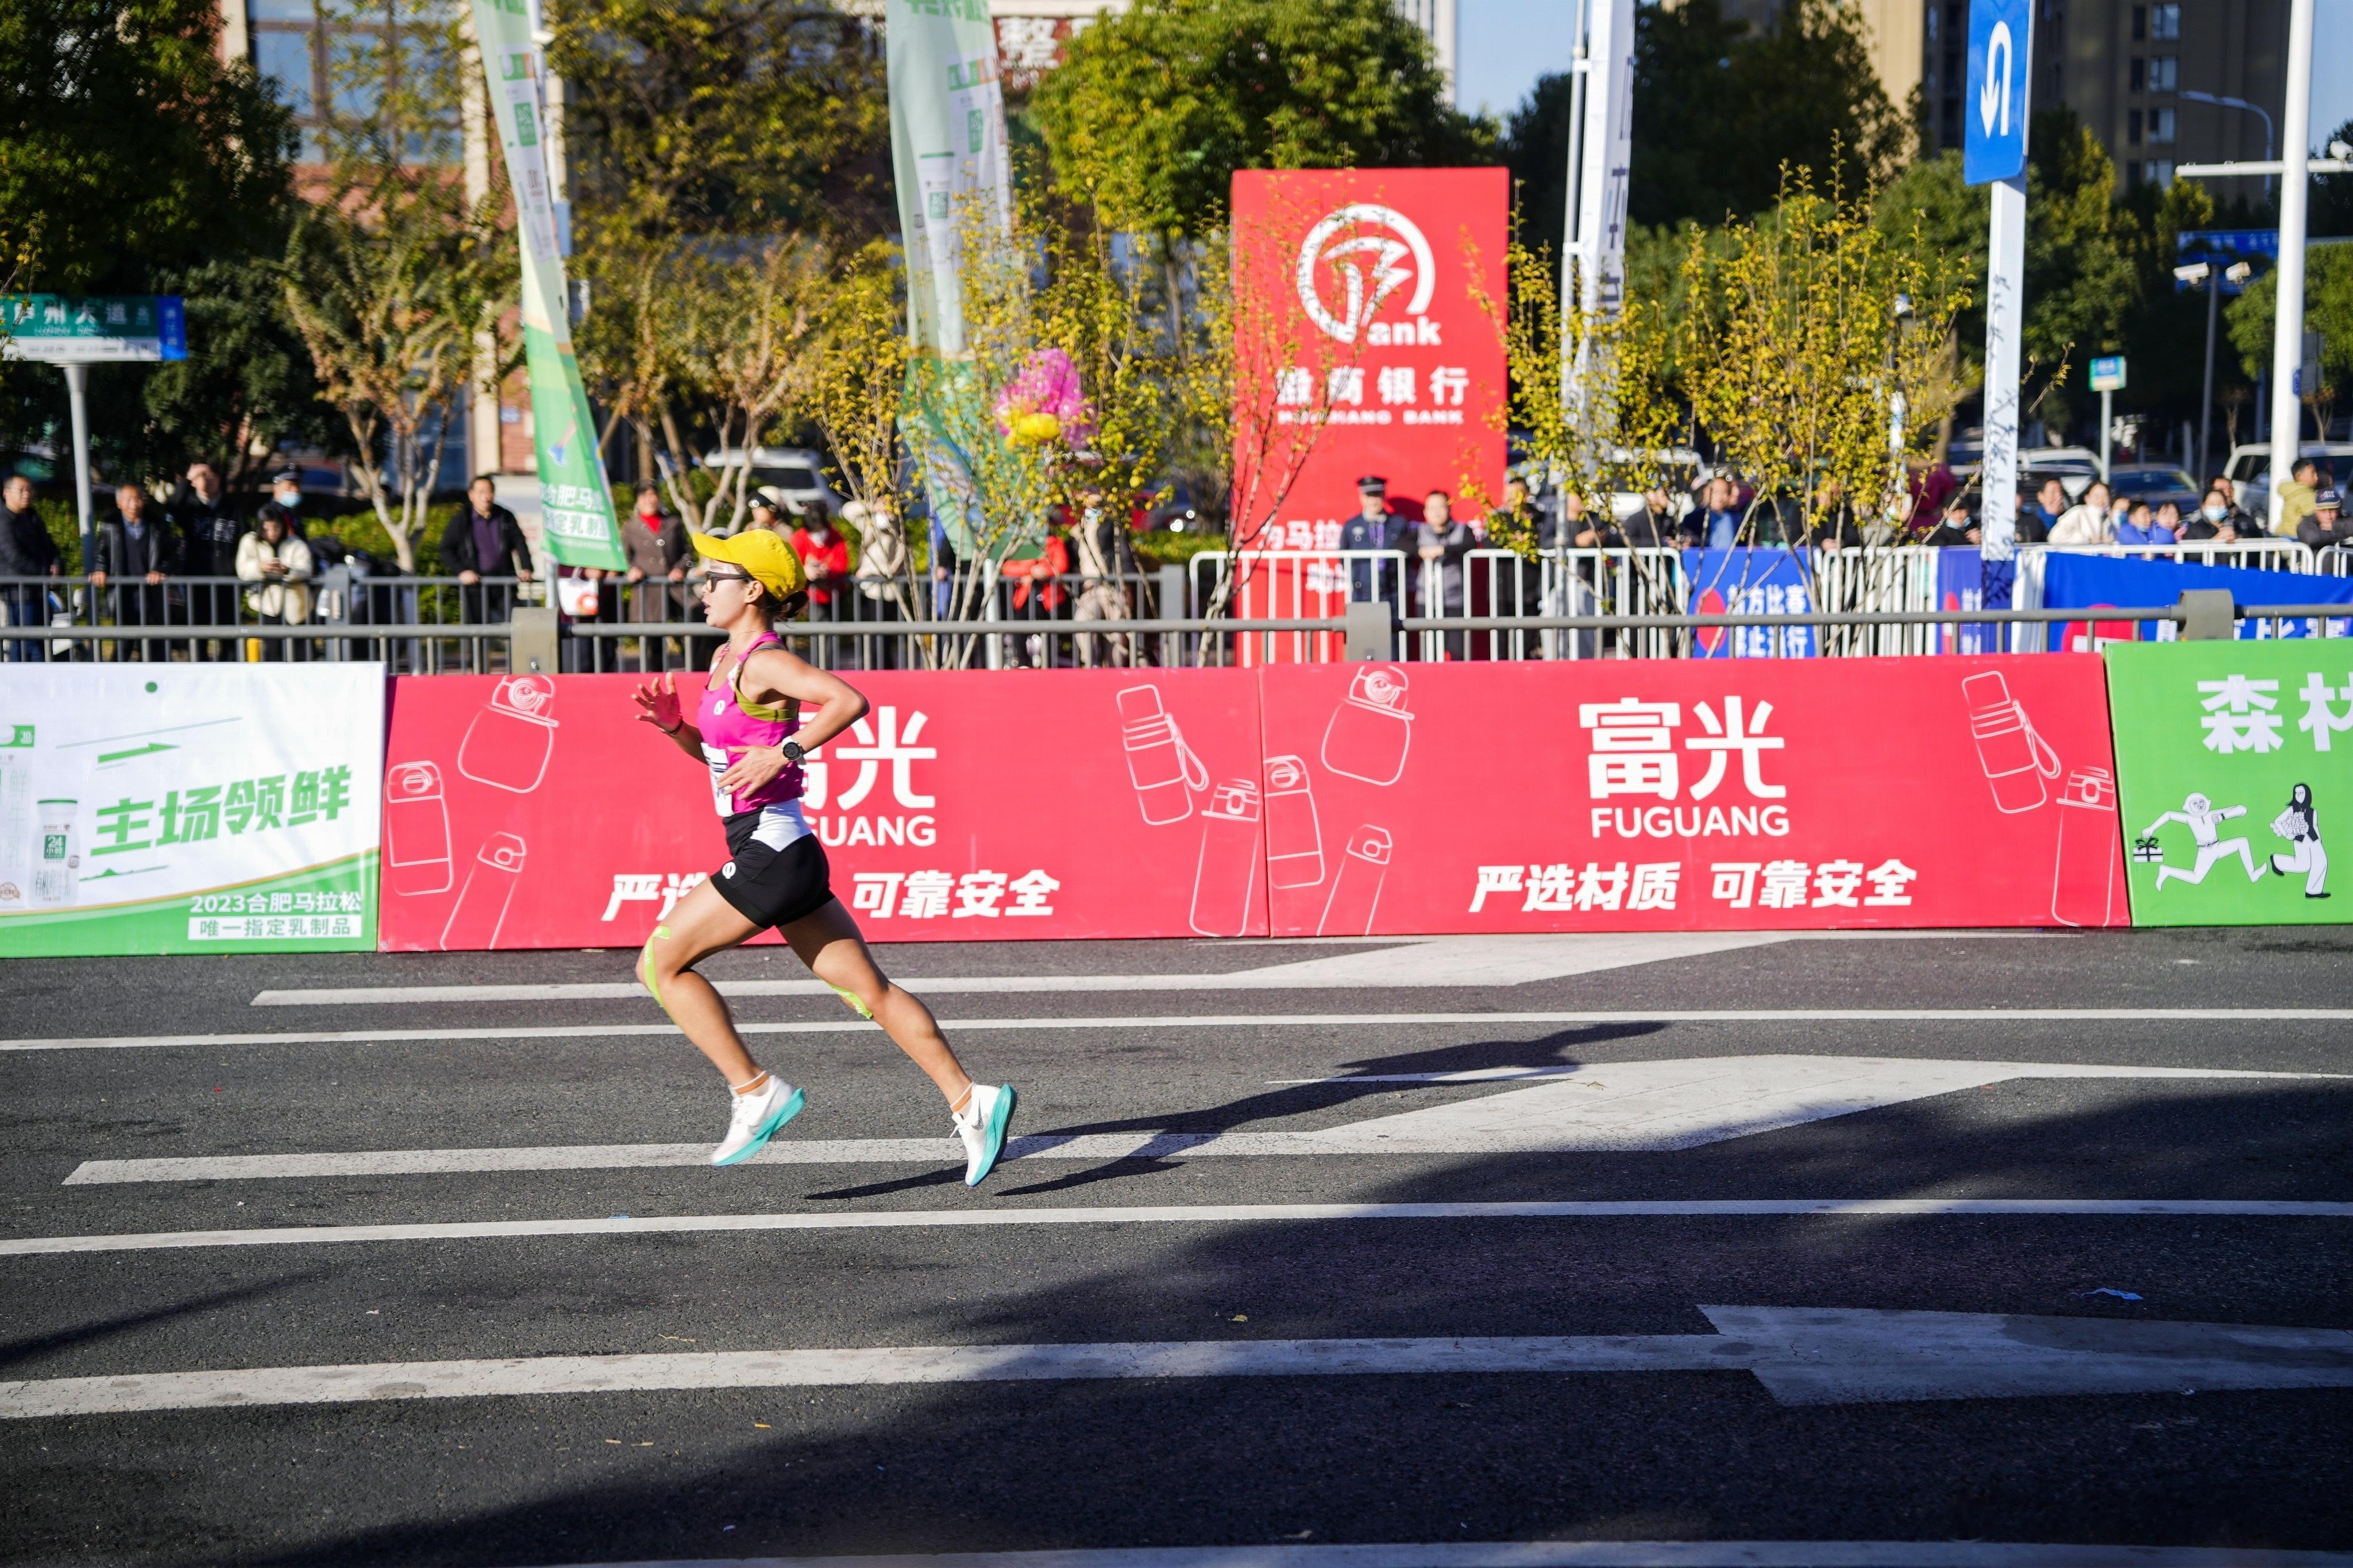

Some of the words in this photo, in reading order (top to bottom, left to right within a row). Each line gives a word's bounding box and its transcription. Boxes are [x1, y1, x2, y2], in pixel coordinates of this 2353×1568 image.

[1403, 410, 1464, 425] BANK
[1579, 696, 1787, 801] 富光
[90, 764, 352, 856] 主场领鲜
[1591, 805, 1789, 838] FUGUANG
[803, 815, 936, 847] UANG
[190, 891, 361, 913] 2023合肥马拉松
[853, 869, 1060, 919] 可靠安全
[1468, 862, 1681, 913] 严选材质
[1710, 859, 1917, 909] 可靠安全
[200, 919, 350, 937] 唯一指定乳制品
